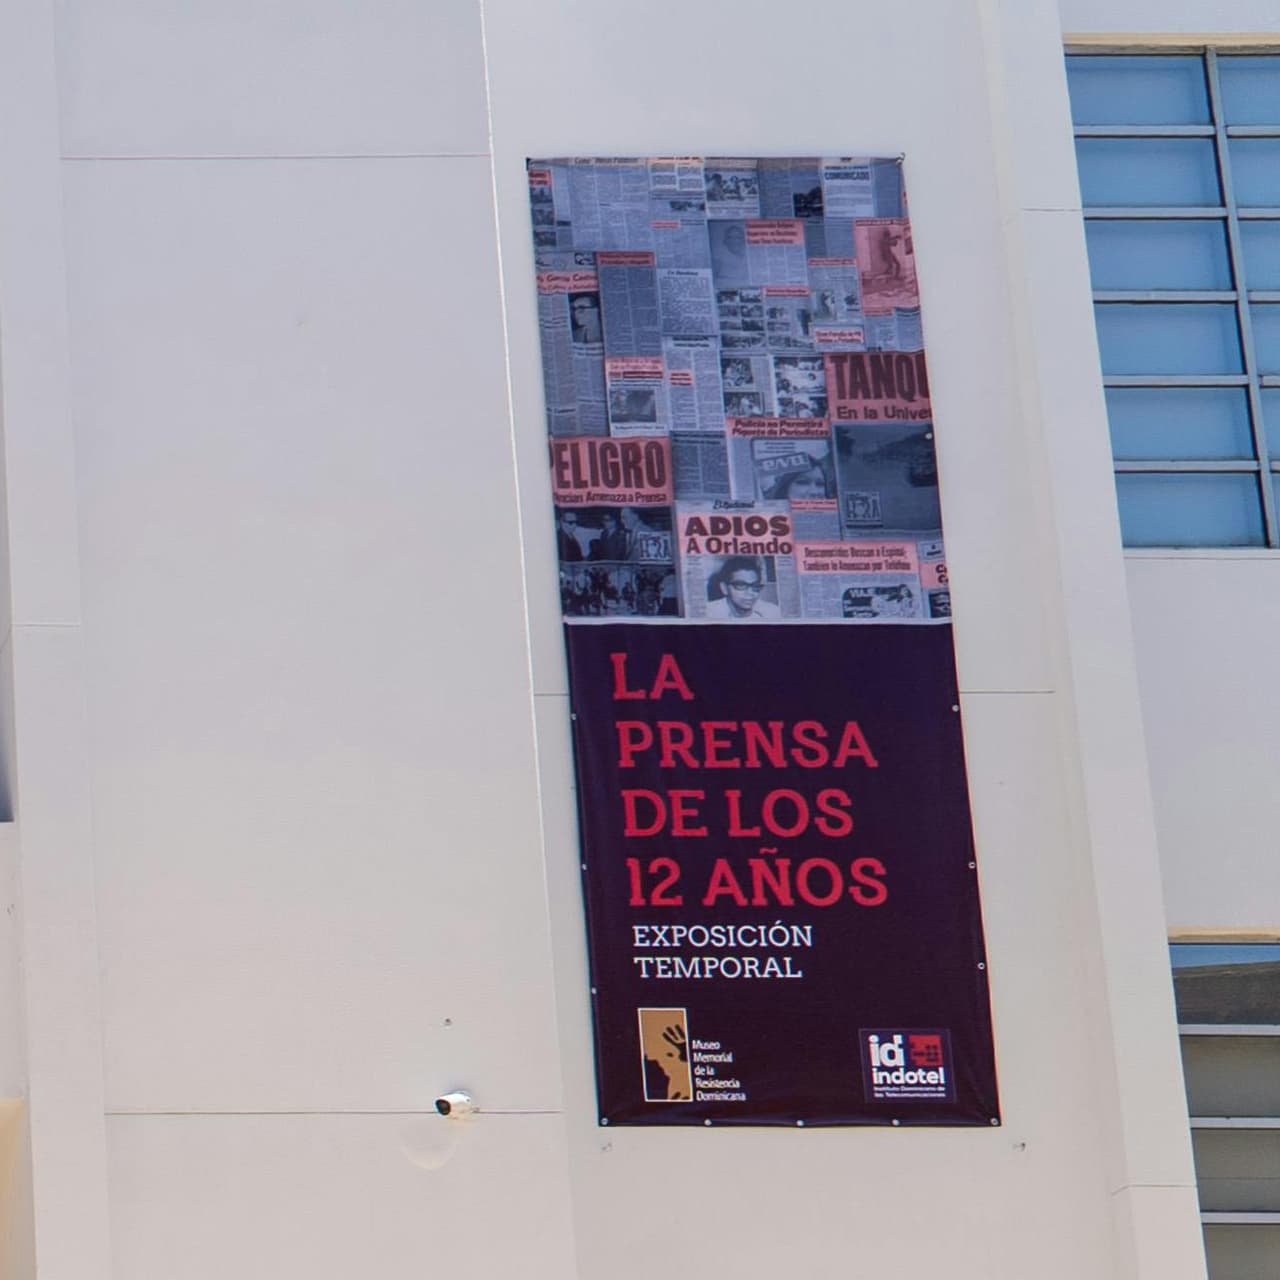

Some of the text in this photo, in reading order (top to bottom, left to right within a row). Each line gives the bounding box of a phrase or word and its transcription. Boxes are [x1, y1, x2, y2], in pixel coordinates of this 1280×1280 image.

[838, 407, 856, 419] En
[864, 406, 877, 419] la
[551, 440, 667, 489] ELIGRO
[685, 515, 791, 536] ADIOS
[686, 536, 793, 555] A Orlando
[610, 652, 694, 700] LA
[615, 720, 878, 768] PRENSA
[621, 788, 854, 838] DE LOS
[625, 847, 888, 907] 12 AÑOS
[633, 920, 813, 947] EXPOSICIÓN
[634, 957, 802, 978] TEMPORAL
[692, 1039, 720, 1050] Museo
[693, 1052, 733, 1063] Memorial
[694, 1065, 705, 1075] de
[872, 1067, 946, 1084] indotel
[696, 1078, 740, 1088] Resistencia
[696, 1091, 746, 1101] Dominicana
